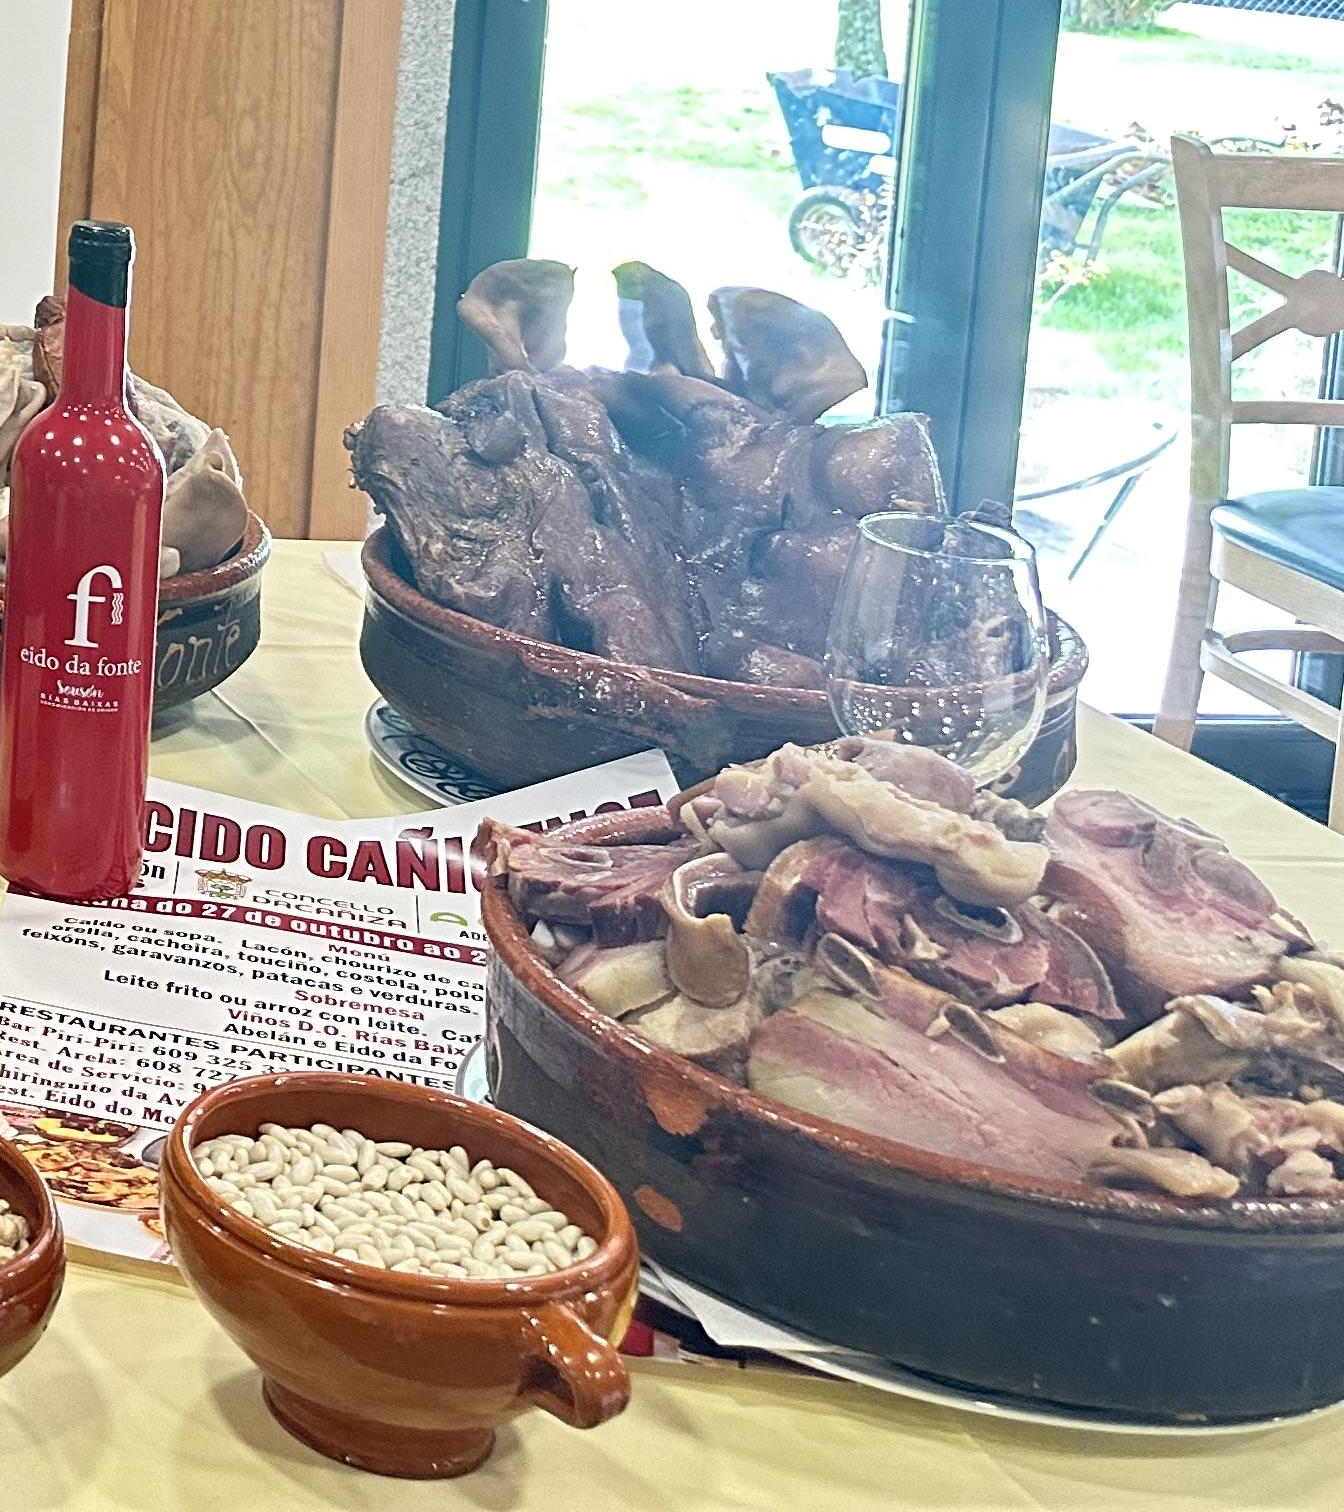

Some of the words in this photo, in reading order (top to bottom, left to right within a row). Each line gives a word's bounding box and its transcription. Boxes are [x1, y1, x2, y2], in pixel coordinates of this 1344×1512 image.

[64, 565, 122, 647] f
[21, 646, 59, 670] eido
[65, 655, 91, 675] da
[97, 657, 141, 676] fonte
[145, 800, 286, 873] CIDO
[265, 885, 393, 917] CONCELLO
[201, 905, 232, 919] 27
[244, 910, 281, 926] de
[290, 919, 414, 950] outubro
[423, 944, 461, 959] ao
[126, 933, 230, 958] cacheira,
[237, 951, 329, 976] touciño,
[336, 969, 428, 993] costela,
[241, 939, 314, 960] Lacón,
[320, 954, 416, 978] chourizo
[327, 943, 390, 962] Menú
[112, 943, 244, 975] garavanzos,
[252, 968, 343, 992] patacas
[368, 989, 479, 1015] verduras.
[103, 970, 158, 989] Leite
[166, 981, 213, 999] frito
[219, 994, 247, 1006] ou
[254, 1000, 312, 1017] arroz
[318, 1011, 360, 1025] con
[368, 1017, 427, 1036] leite.
[294, 990, 424, 1021] Sobremesa
[224, 1022, 306, 1045] Abelán
[335, 1042, 385, 1058] Eido
[392, 1051, 422, 1064] da
[227, 1008, 290, 1028] Viños
[297, 1021, 346, 1037] D.O.
[355, 1028, 406, 1047] Rías
[136, 1057, 182, 1073] 608
[152, 1046, 197, 1061] 609
[206, 1055, 252, 1070] 325
[81, 1064, 185, 1093] Servicio:
[121, 1085, 148, 1099] da
[45, 1089, 97, 1109] Eido
[104, 1101, 133, 1116] do
